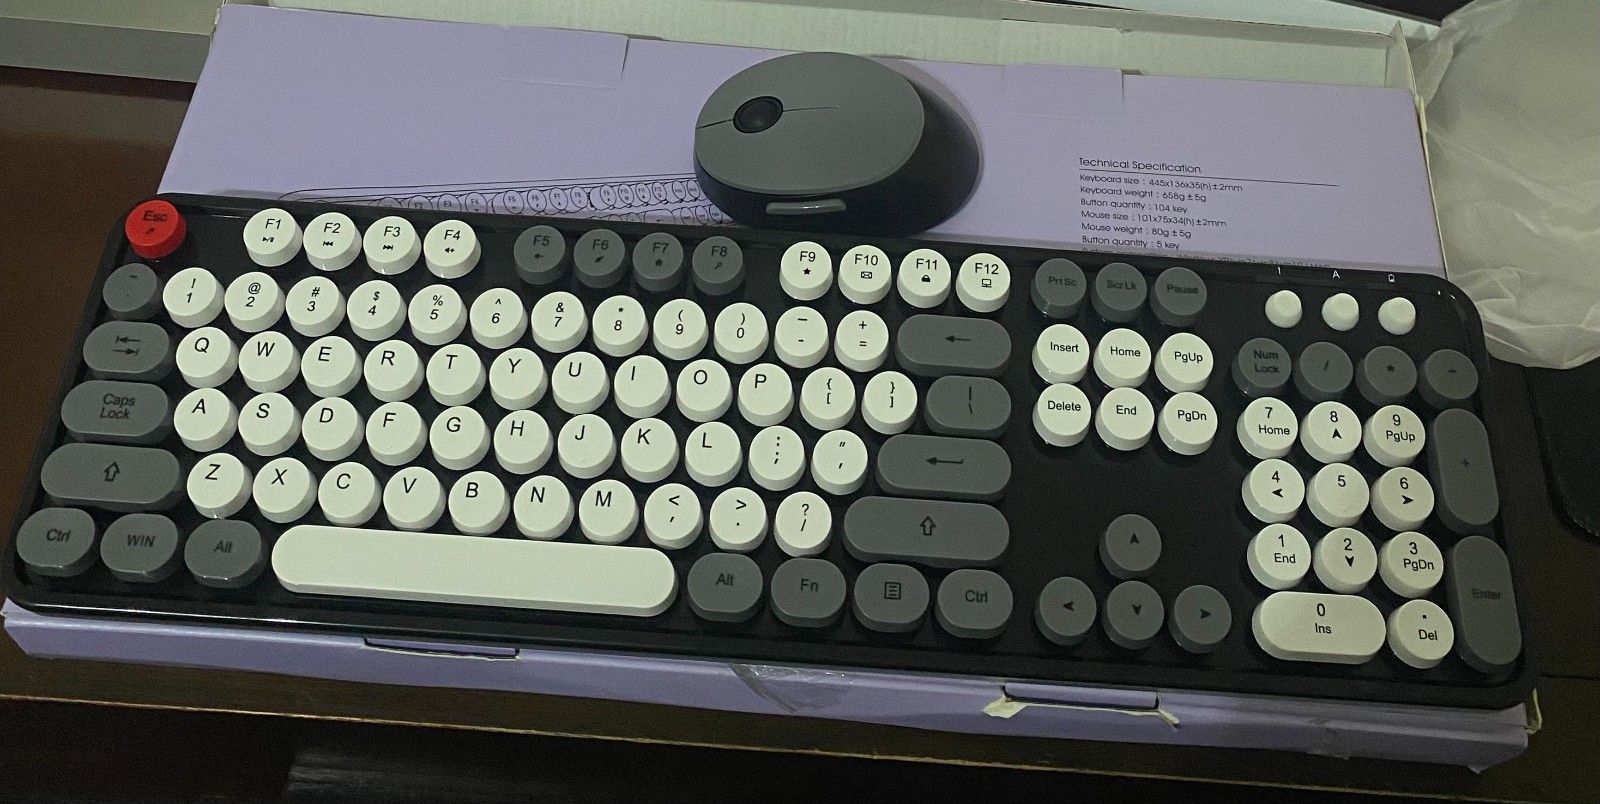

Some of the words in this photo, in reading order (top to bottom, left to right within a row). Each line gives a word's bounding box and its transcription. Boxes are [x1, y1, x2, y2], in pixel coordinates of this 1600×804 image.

[1079, 157, 1129, 169] Technical
[1132, 161, 1201, 173] Specification
[1079, 174, 1122, 184] Keyboard
[1124, 176, 1139, 184] size
[1080, 186, 1122, 196] Keyboard
[1125, 189, 1153, 198] weight
[1163, 192, 1185, 201] 658g
[1081, 199, 1107, 207] Button
[1110, 201, 1145, 211] quantity
[1154, 204, 1170, 212] 104
[1172, 205, 1188, 214] key
[143, 210, 167, 222] Esc
[1081, 211, 1110, 219] Mouse
[265, 218, 281, 229] F1
[324, 222, 341, 233] F2
[384, 226, 400, 237] F3
[444, 230, 460, 240] F4
[1082, 223, 1111, 232] Mouse
[1114, 225, 1142, 234] weight
[1152, 228, 1169, 237] 80g
[533, 235, 550, 246] F5
[592, 239, 609, 250] F6
[1082, 236, 1109, 245] Button
[1112, 237, 1147, 248] quantity
[1165, 241, 1180, 250] key
[653, 242, 669, 253] F7
[711, 245, 727, 257] F8
[800, 251, 816, 262] F9
[855, 254, 878, 266] F10
[916, 258, 937, 270] F11
[975, 263, 998, 275] F12
[1333, 270, 1340, 278] A
[1166, 284, 1199, 294] Pause
[245, 296, 255, 307] 2
[307, 301, 315, 311] 3
[368, 305, 376, 315] 4
[430, 309, 439, 320] 5
[492, 313, 500, 324] 6
[555, 316, 562, 327] 7
[614, 320, 622, 331] 8
[676, 324, 683, 335] 9
[737, 327, 744, 339] 0
[195, 337, 209, 353] Q
[258, 341, 275, 357] W
[1050, 342, 1079, 352] Insert
[318, 346, 332, 361] E
[1110, 346, 1141, 357] Home
[1175, 351, 1203, 363] PgUp
[1254, 350, 1278, 359] Num
[381, 350, 395, 366] R
[446, 354, 458, 369] T
[509, 358, 521, 373] Y
[569, 362, 582, 377] U
[1255, 363, 1279, 373] Lock
[694, 370, 707, 385] O
[755, 374, 767, 388] P
[103, 393, 135, 408] Caps
[192, 399, 205, 414] A
[1048, 400, 1081, 411] Delete
[100, 407, 130, 419] Lock
[256, 403, 270, 418] S
[319, 408, 333, 423] D
[1116, 405, 1136, 415] End
[1178, 410, 1207, 422] PgDn
[1265, 407, 1273, 418] 7
[383, 412, 396, 427] F
[1330, 411, 1338, 422] 8
[1393, 414, 1401, 426] 9
[447, 417, 461, 432] G
[510, 420, 524, 436] H
[1259, 424, 1290, 435] Home
[575, 425, 585, 440] J
[637, 428, 651, 444] K
[1386, 430, 1415, 443] PgUp
[702, 432, 712, 448] L
[205, 464, 221, 480] Z
[271, 469, 287, 485] X
[1272, 471, 1280, 483] 4
[337, 473, 351, 489] C
[403, 477, 417, 493] V
[1338, 475, 1346, 487] 5
[1400, 477, 1409, 489] 6
[466, 482, 478, 498] B
[531, 486, 545, 503] N
[595, 491, 612, 507] M
[46, 529, 71, 542] Ctrl
[128, 534, 155, 547] WIN
[214, 541, 232, 553] Alt
[1344, 538, 1352, 551] 2
[1409, 542, 1418, 555] 3
[1274, 553, 1296, 563] End
[1403, 558, 1434, 571] PgDn
[716, 573, 734, 586] Alt
[801, 578, 818, 592] Fn
[965, 590, 988, 603] Ctrl
[1472, 588, 1501, 600] Enter
[1317, 603, 1325, 617] 0
[1315, 623, 1331, 634] Ins
[1418, 629, 1438, 640] Del
